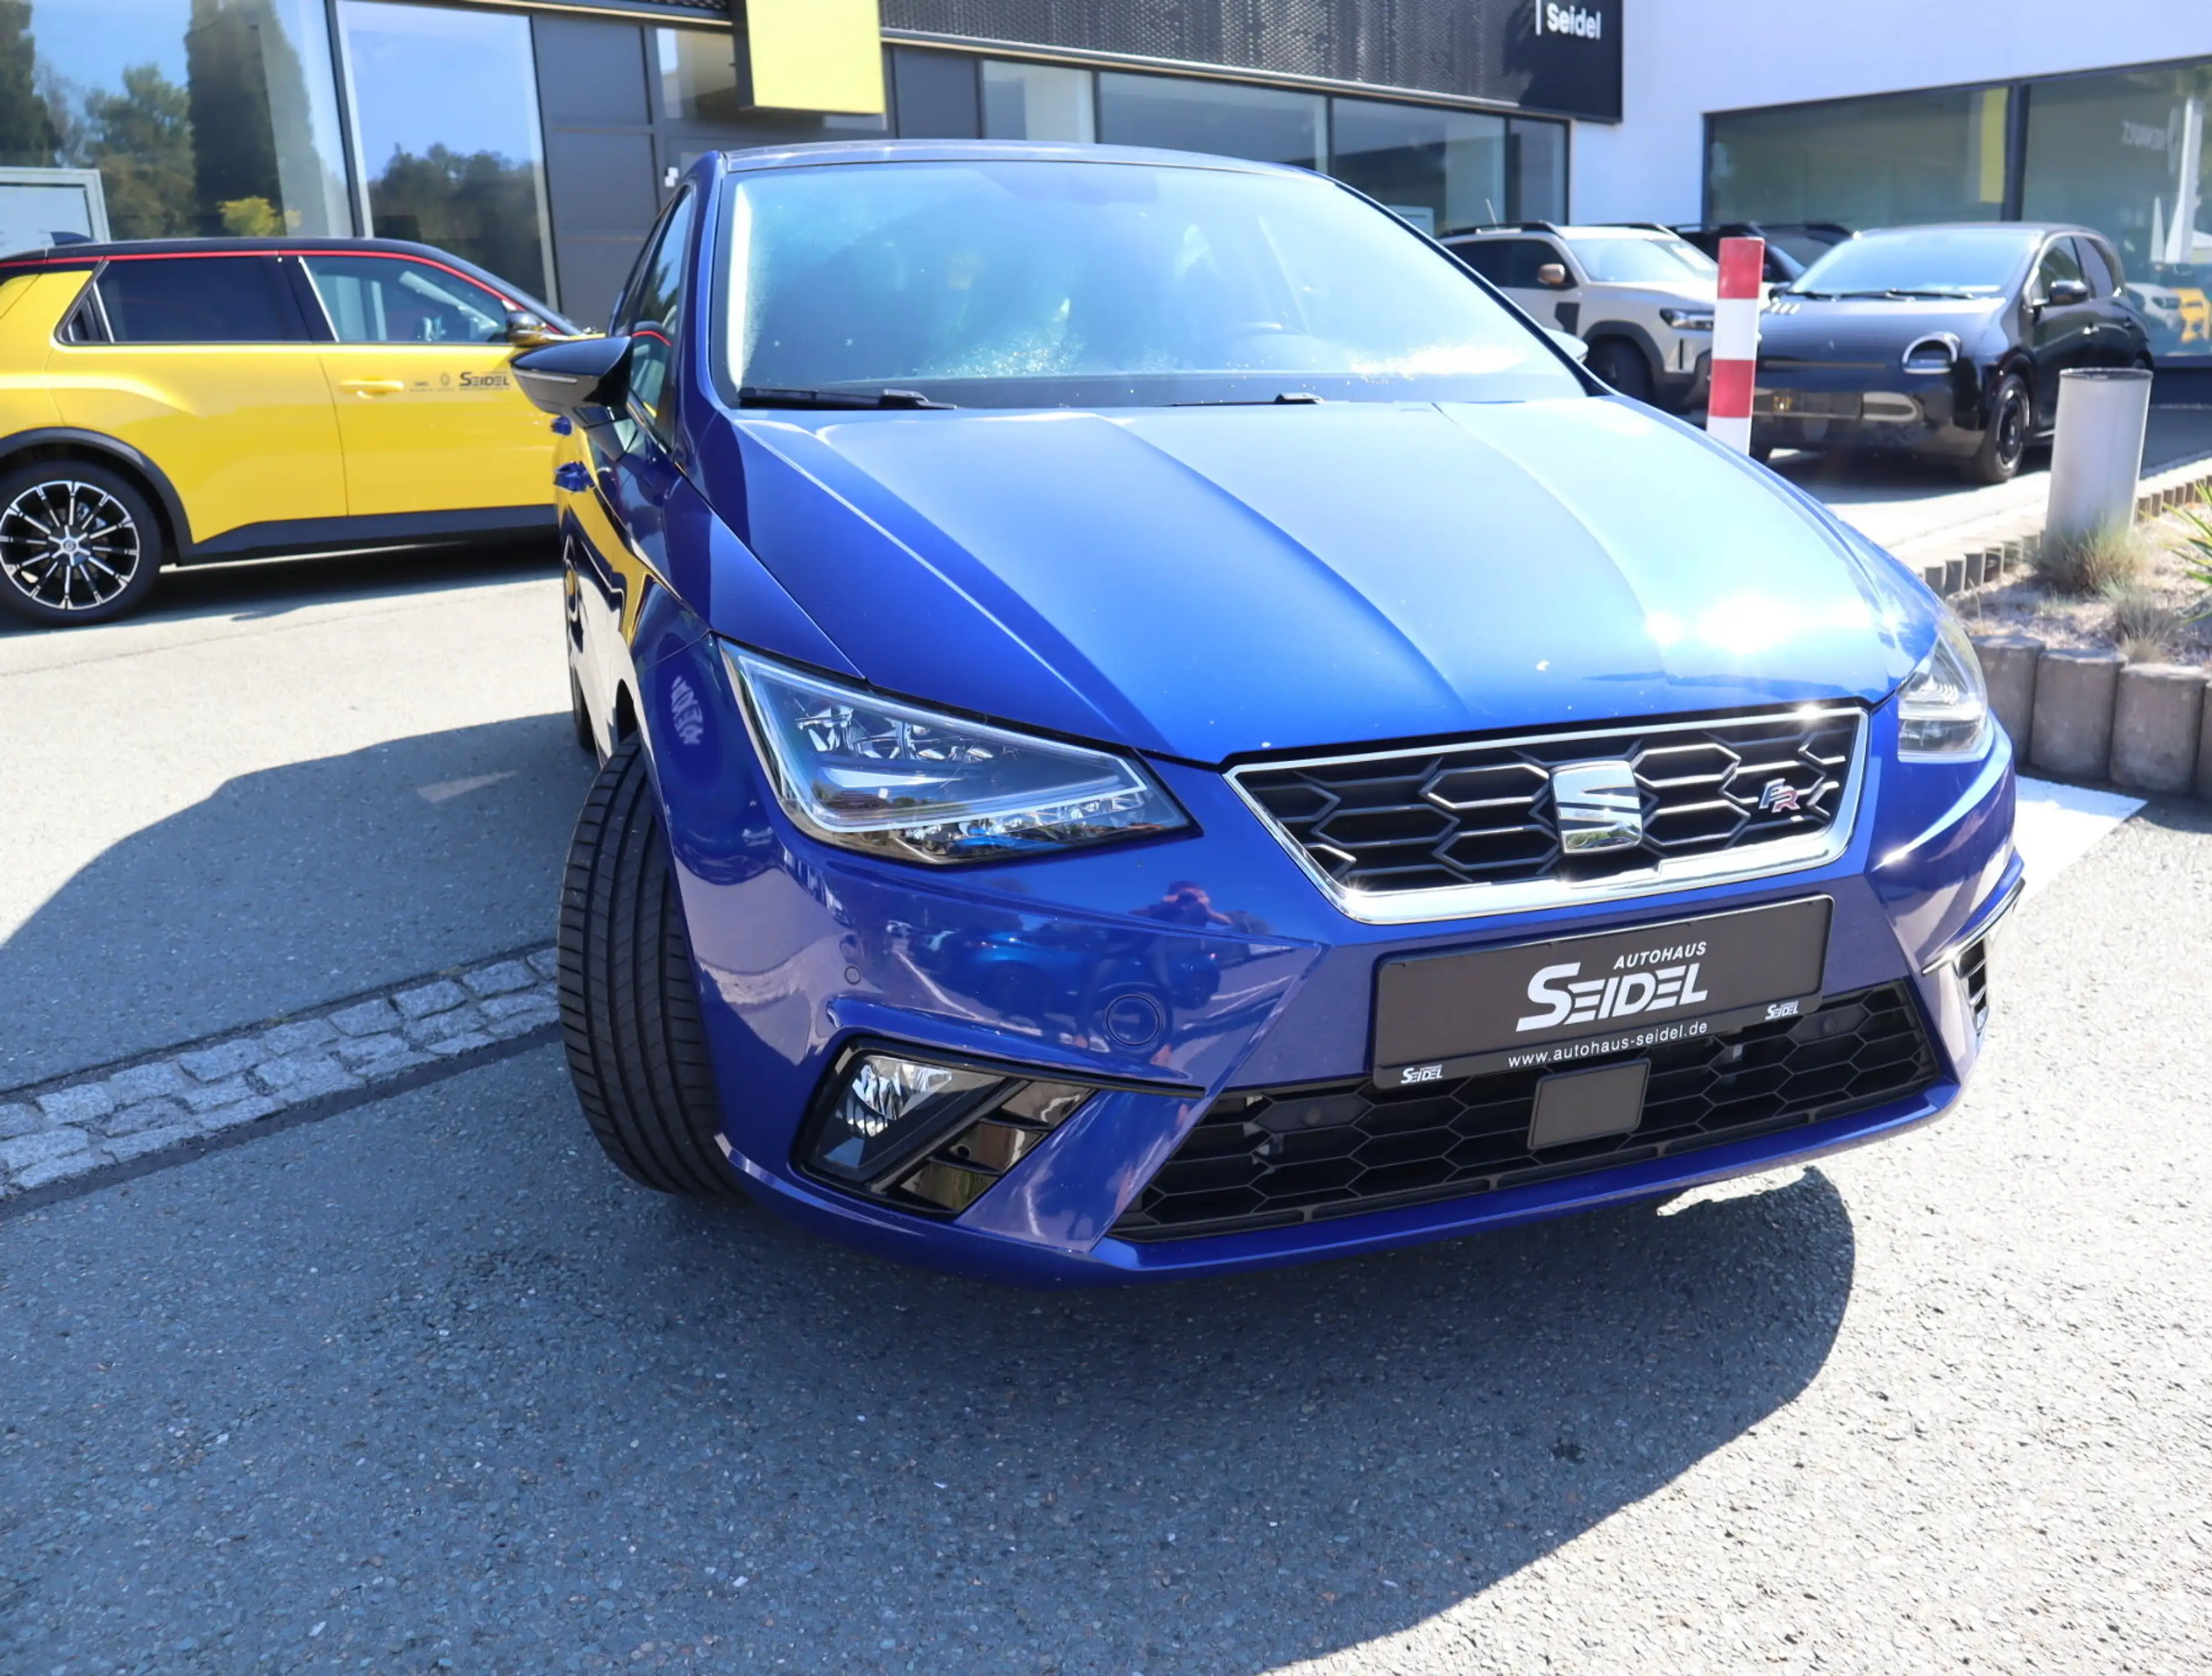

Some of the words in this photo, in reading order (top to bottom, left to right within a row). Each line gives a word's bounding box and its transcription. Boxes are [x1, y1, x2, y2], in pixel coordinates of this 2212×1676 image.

[1547, 2, 1601, 39] Seidel
[459, 371, 510, 386] SEIDEL
[1759, 778, 1800, 813] FR
[1613, 941, 1707, 970] AUTOHAUS
[1516, 961, 1708, 1032] SEIDEL
[1765, 1002, 1798, 1020] SEIDEL
[1508, 1021, 1707, 1068] www.autohaus-seidel.de
[1401, 1065, 1443, 1084] SEIDEL
